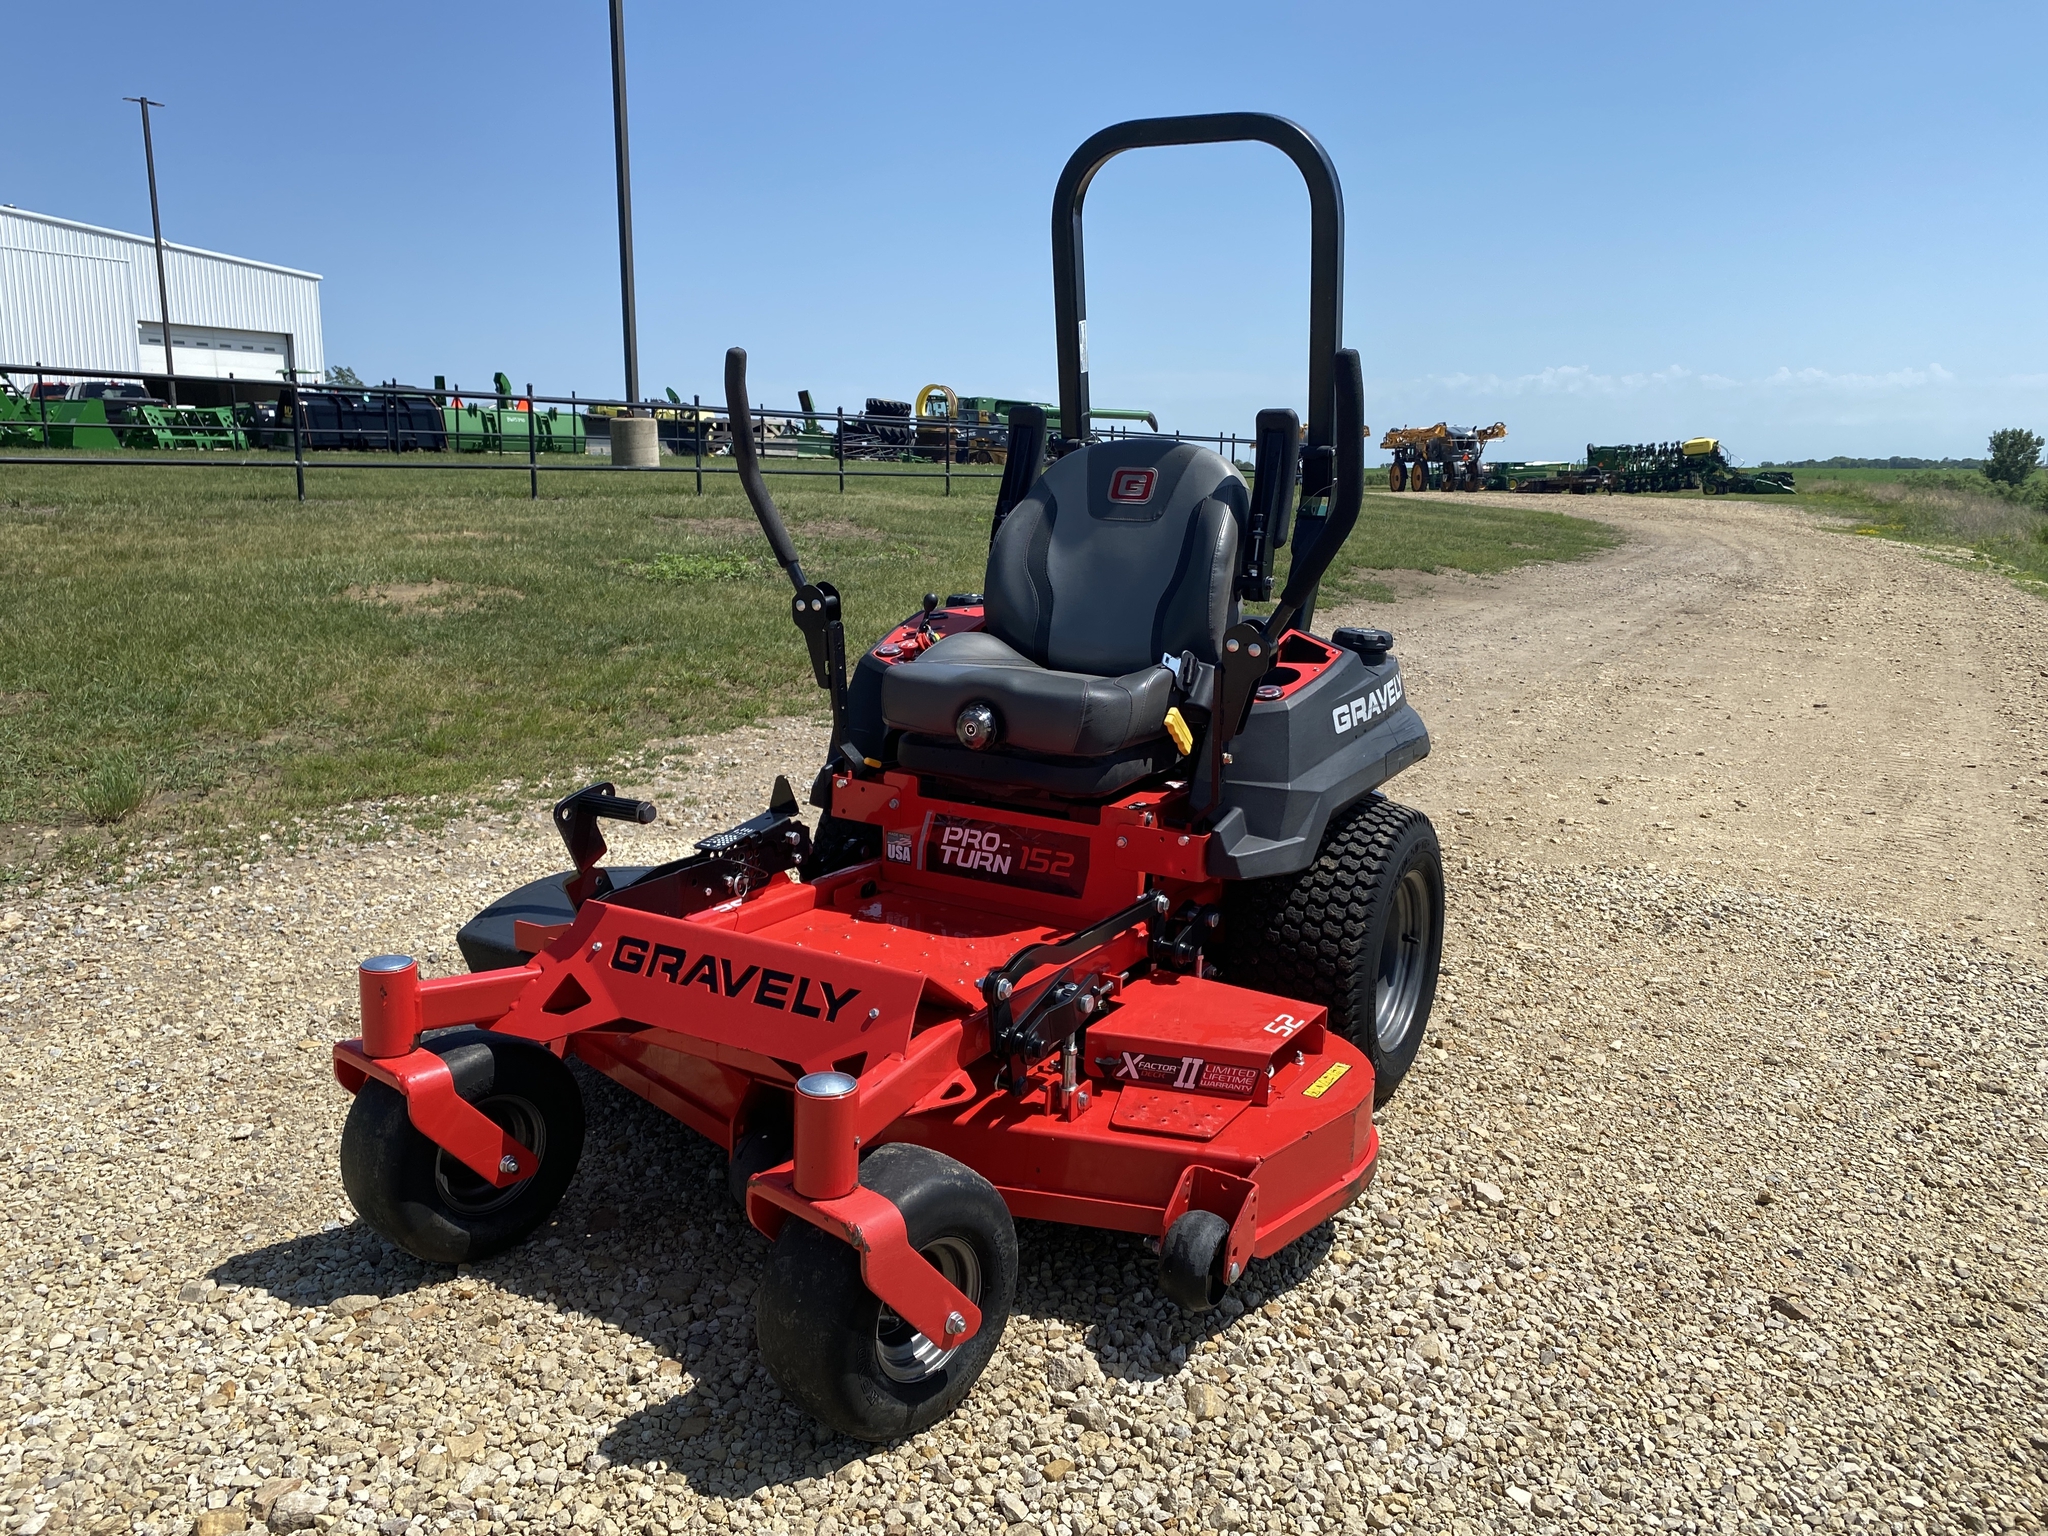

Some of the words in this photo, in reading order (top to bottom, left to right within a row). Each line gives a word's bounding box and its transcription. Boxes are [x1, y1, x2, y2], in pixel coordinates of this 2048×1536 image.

[1118, 474, 1147, 496] G
[1332, 670, 1403, 734] GRAVELY
[942, 827, 1011, 851] PRO-
[887, 843, 911, 862] USA
[940, 845, 1012, 875] TURN
[1019, 845, 1075, 877] 152
[609, 935, 862, 1023] GRAVELY
[1263, 1014, 1305, 1037] 52
[1138, 1061, 1177, 1073] FACTOR
[1173, 1057, 1204, 1090] II
[1140, 1070, 1166, 1079] DECK
[1202, 1073, 1255, 1085] LIFETIME
[1205, 1064, 1257, 1078] LIMITED
[1200, 1080, 1253, 1092] WARRANTY
